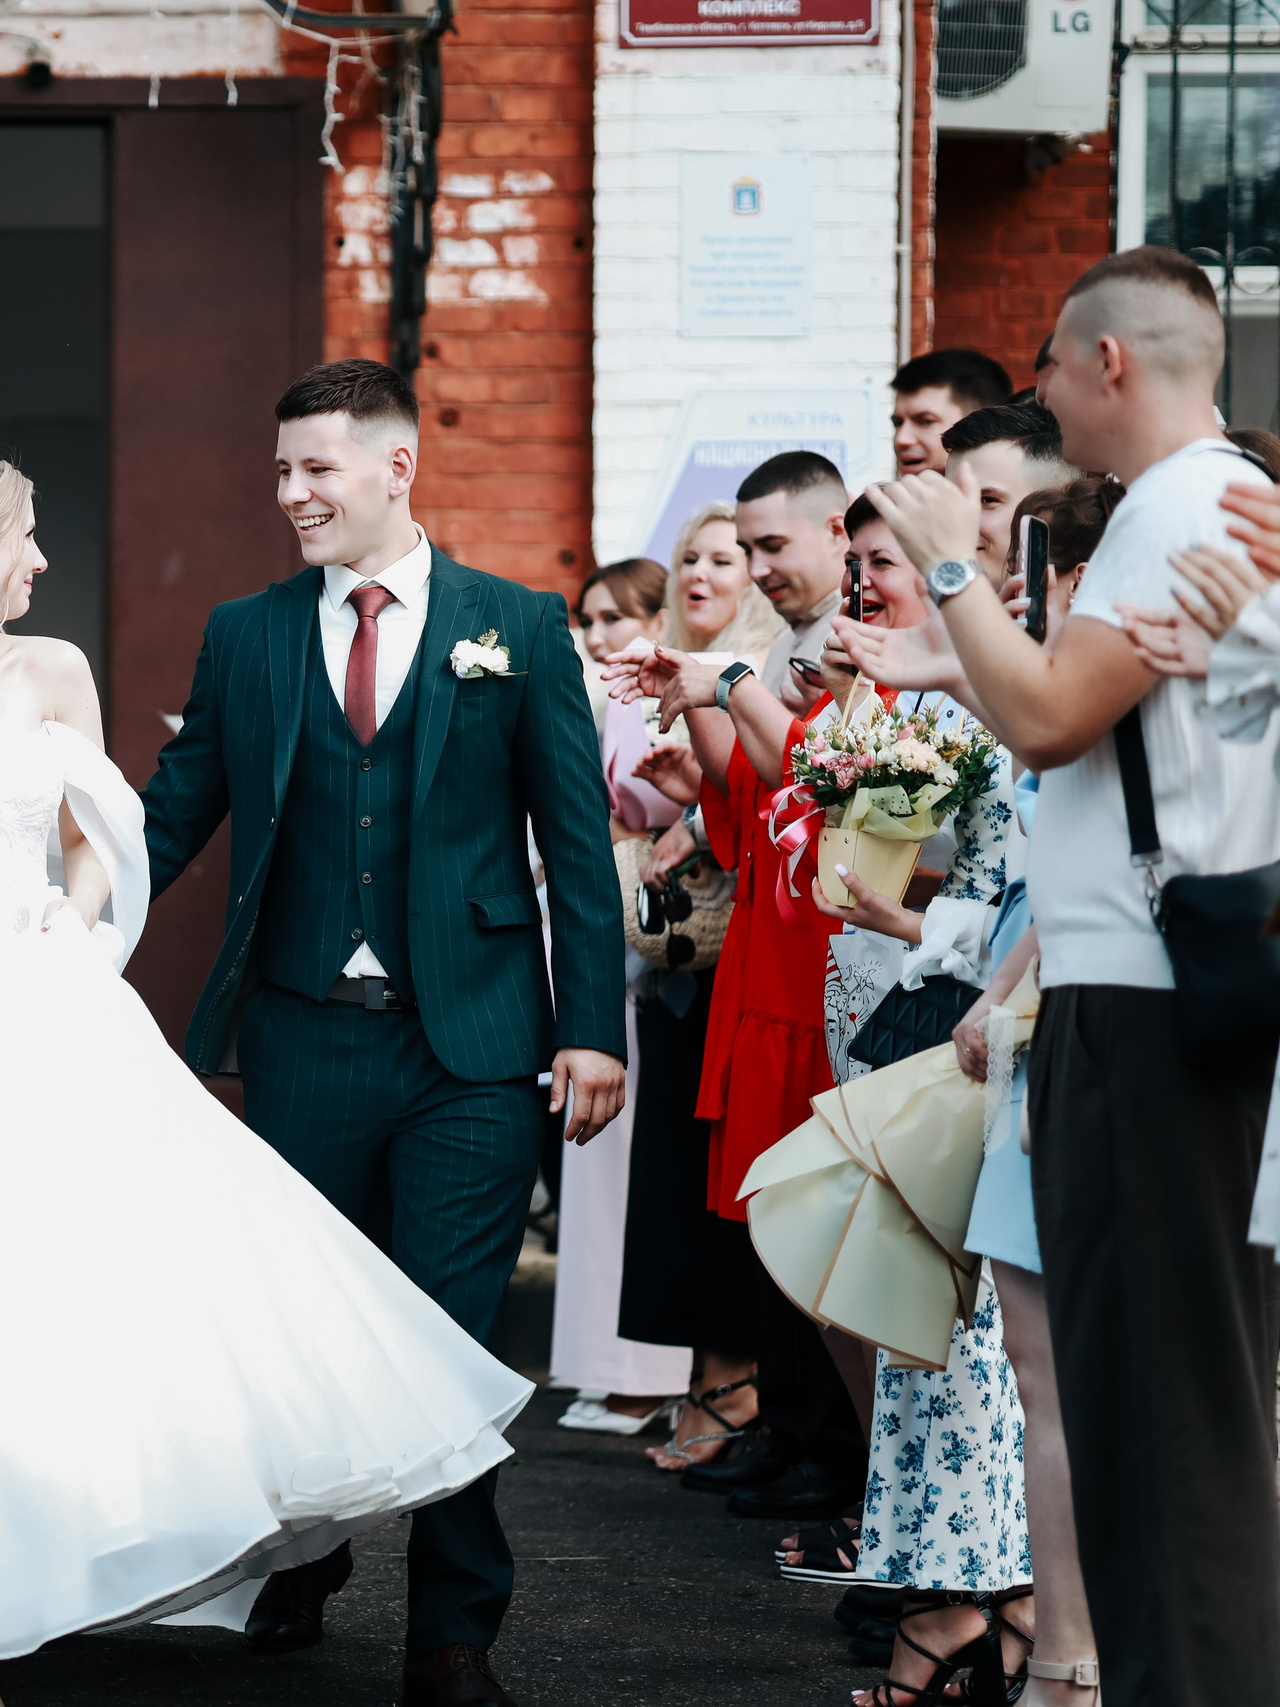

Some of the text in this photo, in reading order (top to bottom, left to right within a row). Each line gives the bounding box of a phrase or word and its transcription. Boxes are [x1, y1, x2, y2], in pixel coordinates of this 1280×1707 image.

[698, 0, 801, 16] КОМПЛЕКС
[1052, 10, 1090, 33] LG
[747, 410, 844, 427] КУЛЬТУРА
